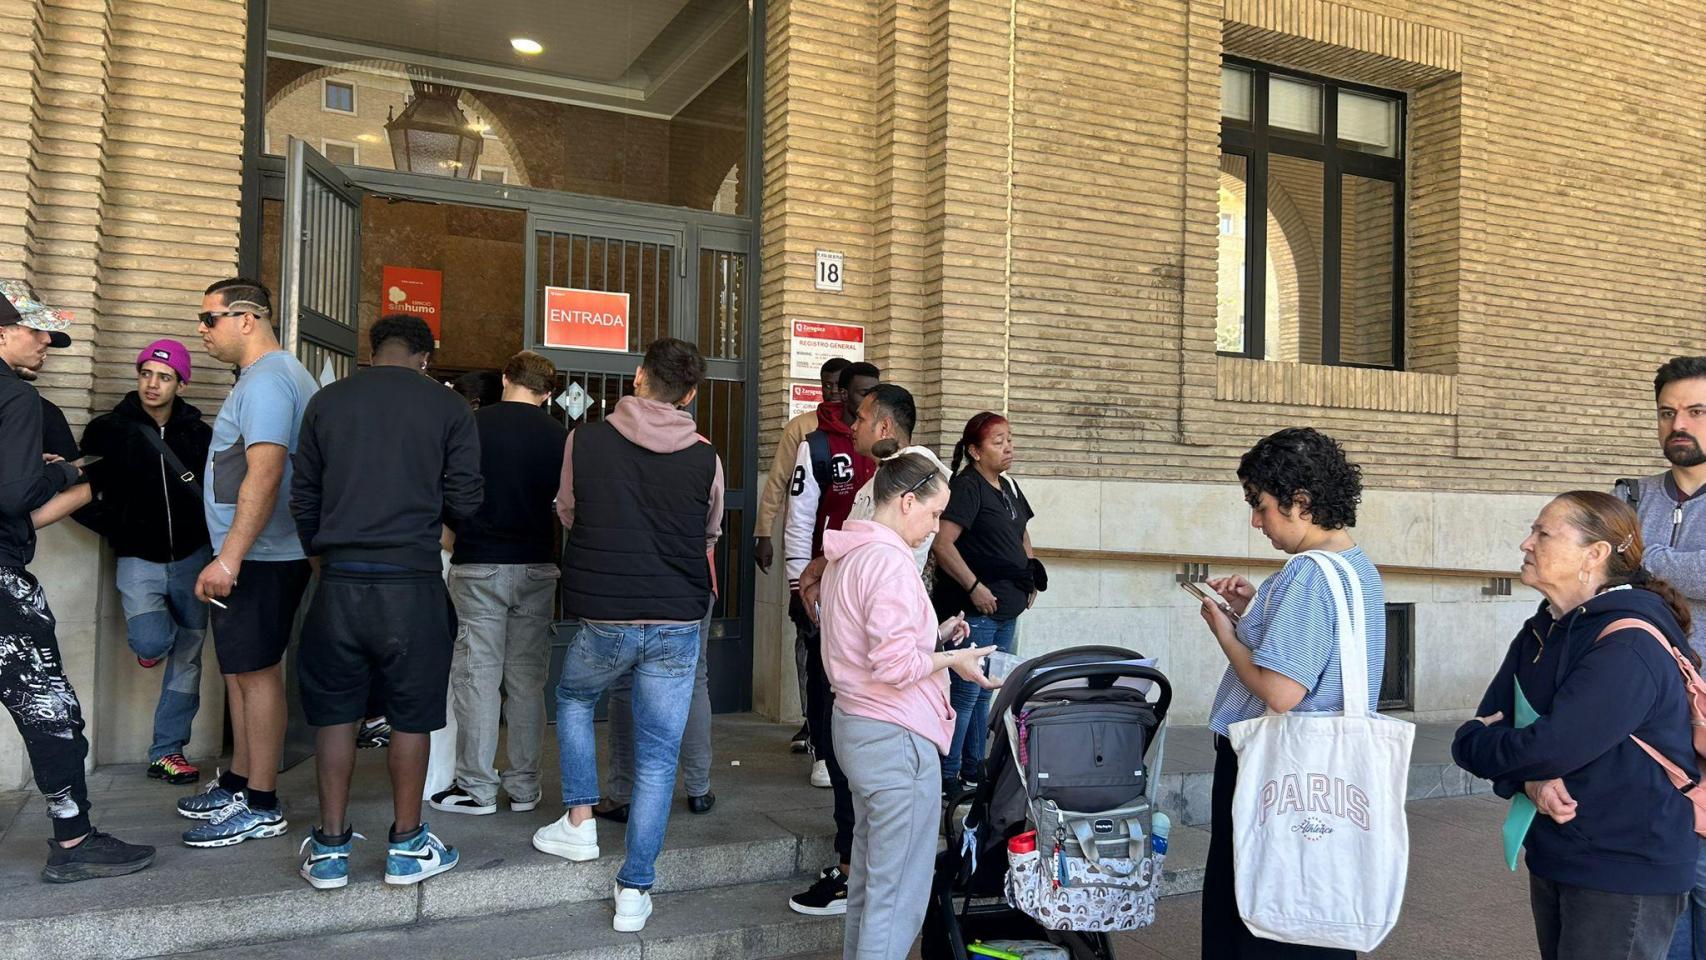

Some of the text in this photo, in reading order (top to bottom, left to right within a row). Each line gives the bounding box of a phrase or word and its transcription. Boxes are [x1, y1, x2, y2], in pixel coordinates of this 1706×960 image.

[820, 262, 838, 283] 18
[388, 303, 435, 314] sinhumo
[550, 309, 624, 327] ENTRADA
[800, 340, 829, 348] REGISTRO
[1258, 772, 1370, 831] PARIS
